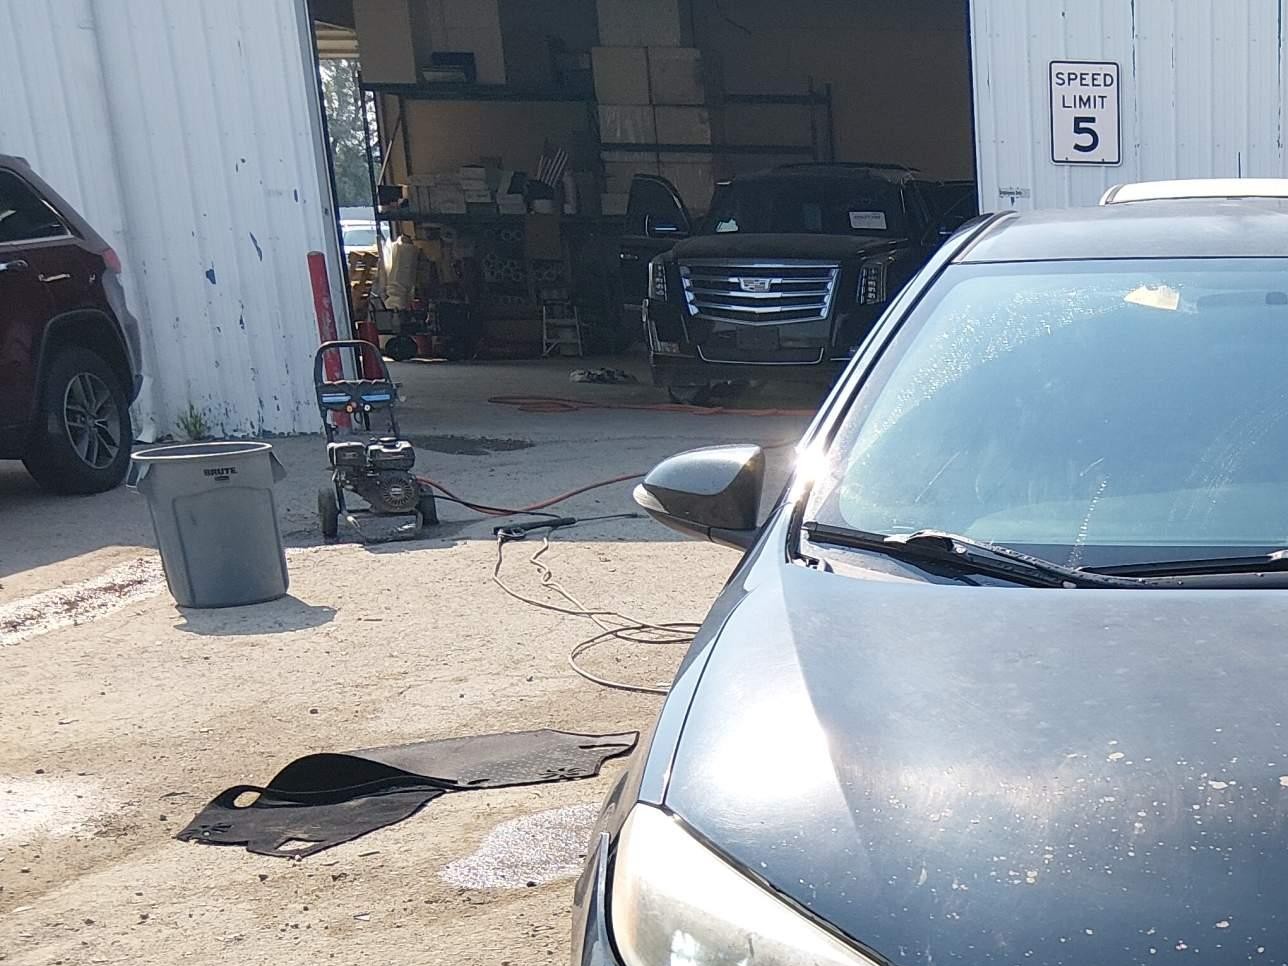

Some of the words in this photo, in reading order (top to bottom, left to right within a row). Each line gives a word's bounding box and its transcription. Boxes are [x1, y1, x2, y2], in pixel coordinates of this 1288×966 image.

[1055, 72, 1114, 87] SPEED
[1062, 95, 1107, 109] LIMIT
[1073, 116, 1099, 153] 5
